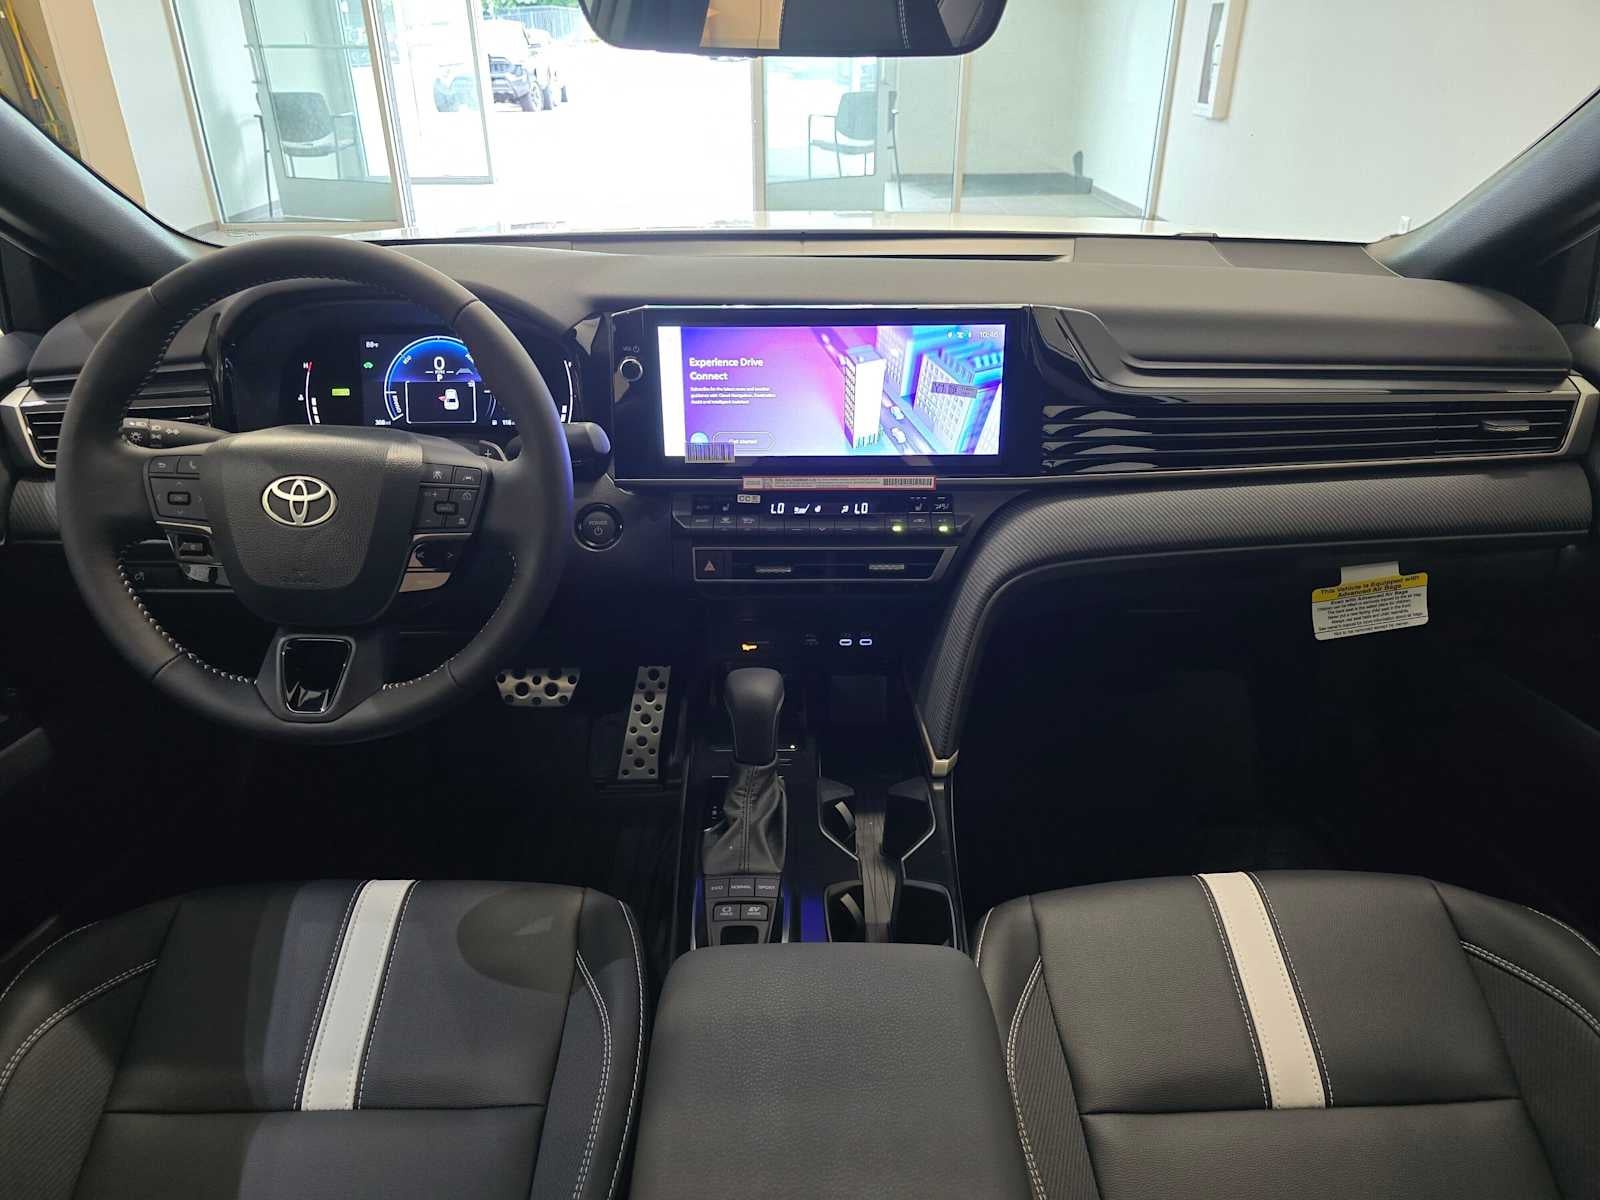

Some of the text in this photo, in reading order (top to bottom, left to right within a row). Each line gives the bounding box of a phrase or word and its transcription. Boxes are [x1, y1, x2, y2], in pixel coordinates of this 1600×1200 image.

[689, 357, 764, 368] Experience Drive
[689, 371, 728, 380] Connect
